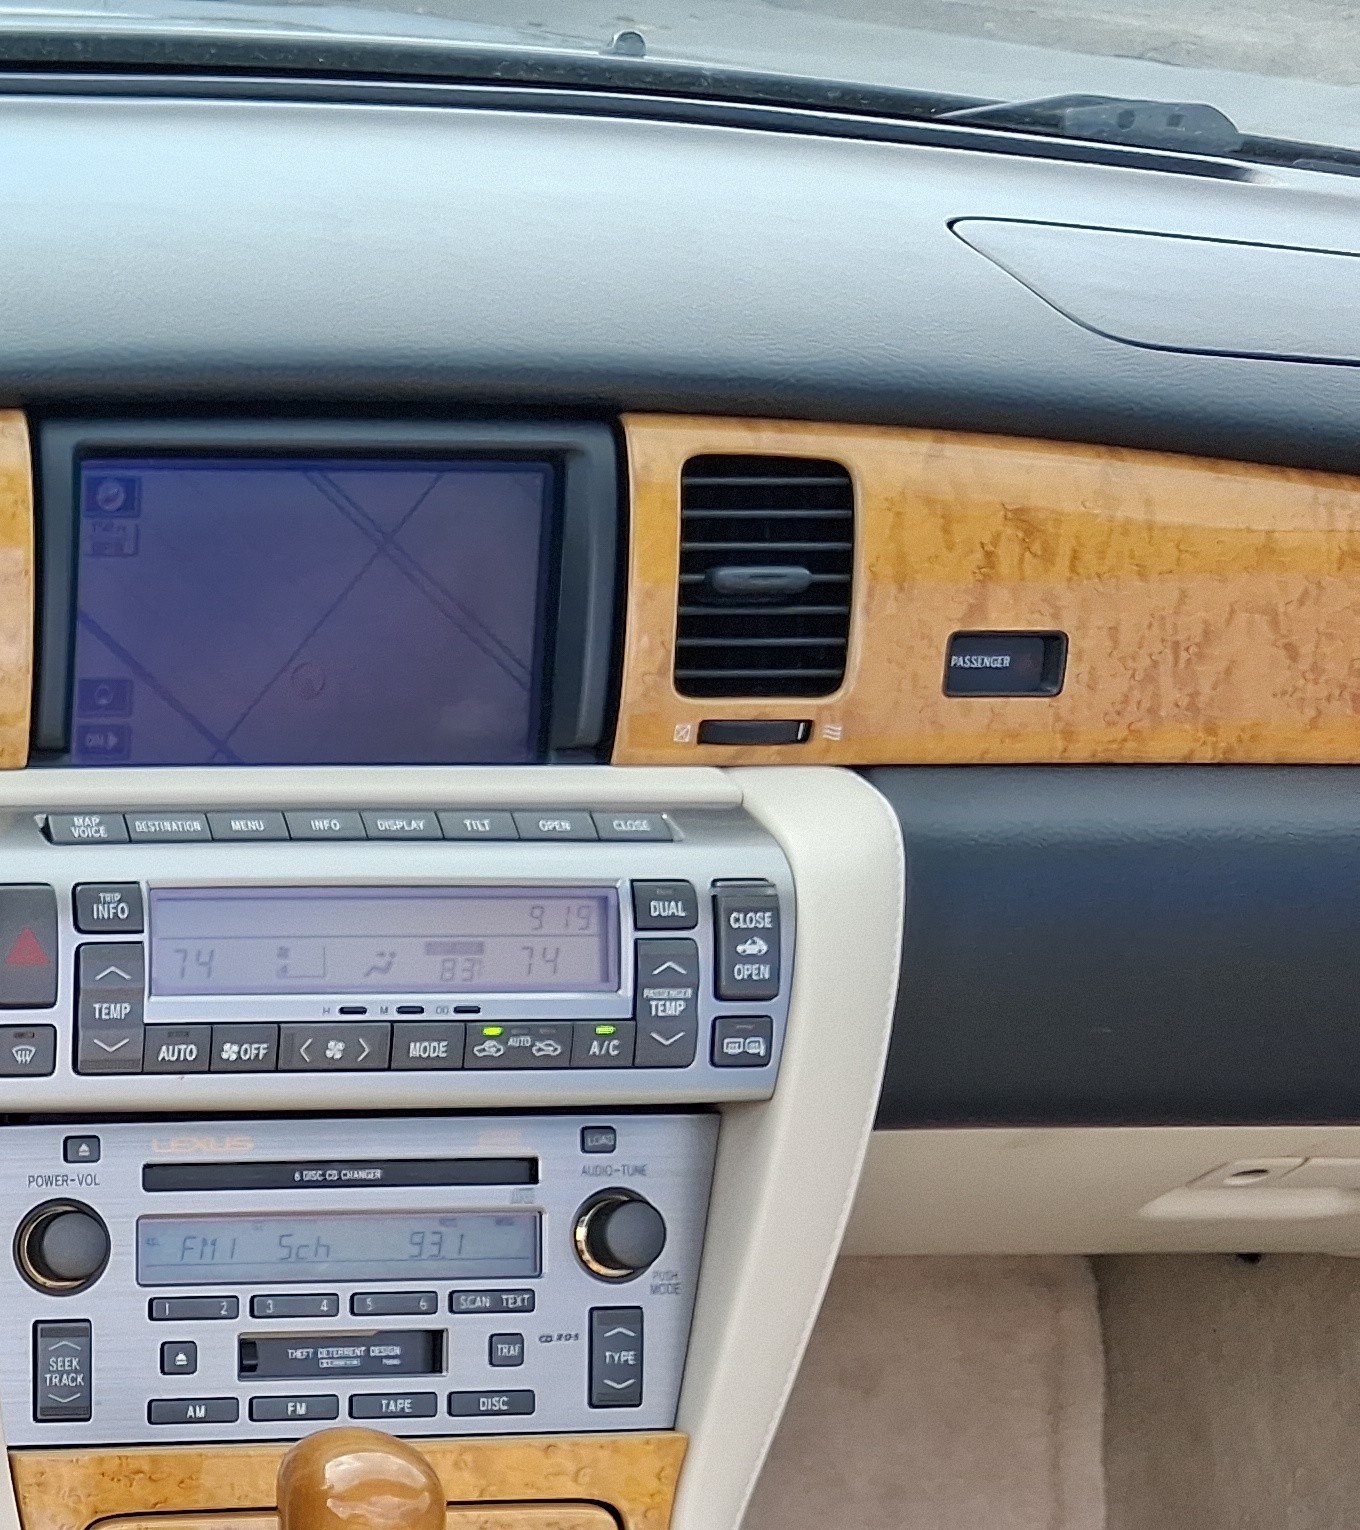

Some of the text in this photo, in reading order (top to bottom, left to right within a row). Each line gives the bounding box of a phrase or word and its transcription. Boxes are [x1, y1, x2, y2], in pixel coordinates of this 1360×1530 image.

[951, 656, 1010, 667] PASSENGER
[73, 816, 99, 826] MAP
[135, 820, 201, 831] DESTINATION
[230, 820, 264, 831] MENU
[311, 820, 340, 831] INFO
[377, 820, 424, 830] DISPLAY
[464, 820, 490, 831] TILT
[539, 820, 570, 831] OPEN
[613, 820, 650, 831] CLOSE
[70, 826, 107, 838] VOICE
[99, 893, 121, 903] TRIP
[93, 903, 129, 920] INFO
[650, 901, 686, 917] DUAL
[730, 912, 772, 928] CLOSE
[734, 963, 770, 980] OPEN
[93, 1003, 130, 1019] TEMP
[650, 1001, 686, 1017] TEMP
[508, 1037, 531, 1047] AUTO
[589, 1040, 620, 1056] A/C
[158, 1045, 197, 1061] AUTO
[240, 1044, 269, 1060] OFF
[409, 1041, 447, 1058] MODE
[303, 1171, 323, 1181] DISC
[326, 1171, 338, 1180] CD
[341, 1170, 382, 1181] CHANGER
[581, 1164, 648, 1177] AUDIO-TUNE
[28, 1174, 100, 1187] POWER-VOL
[266, 1300, 328, 1312] 3 4
[420, 1298, 427, 1310] 6
[460, 1294, 530, 1308] SCAN TEXT
[220, 1302, 227, 1314] 2
[288, 1348, 313, 1359] THEFT
[605, 1352, 636, 1364] TYPE
[49, 1358, 80, 1369] SEEK
[44, 1374, 84, 1386] TRACK
[287, 1403, 306, 1415] FM
[381, 1400, 412, 1412] TAPE
[479, 1397, 509, 1410] DISC
[186, 1406, 206, 1418] AM
